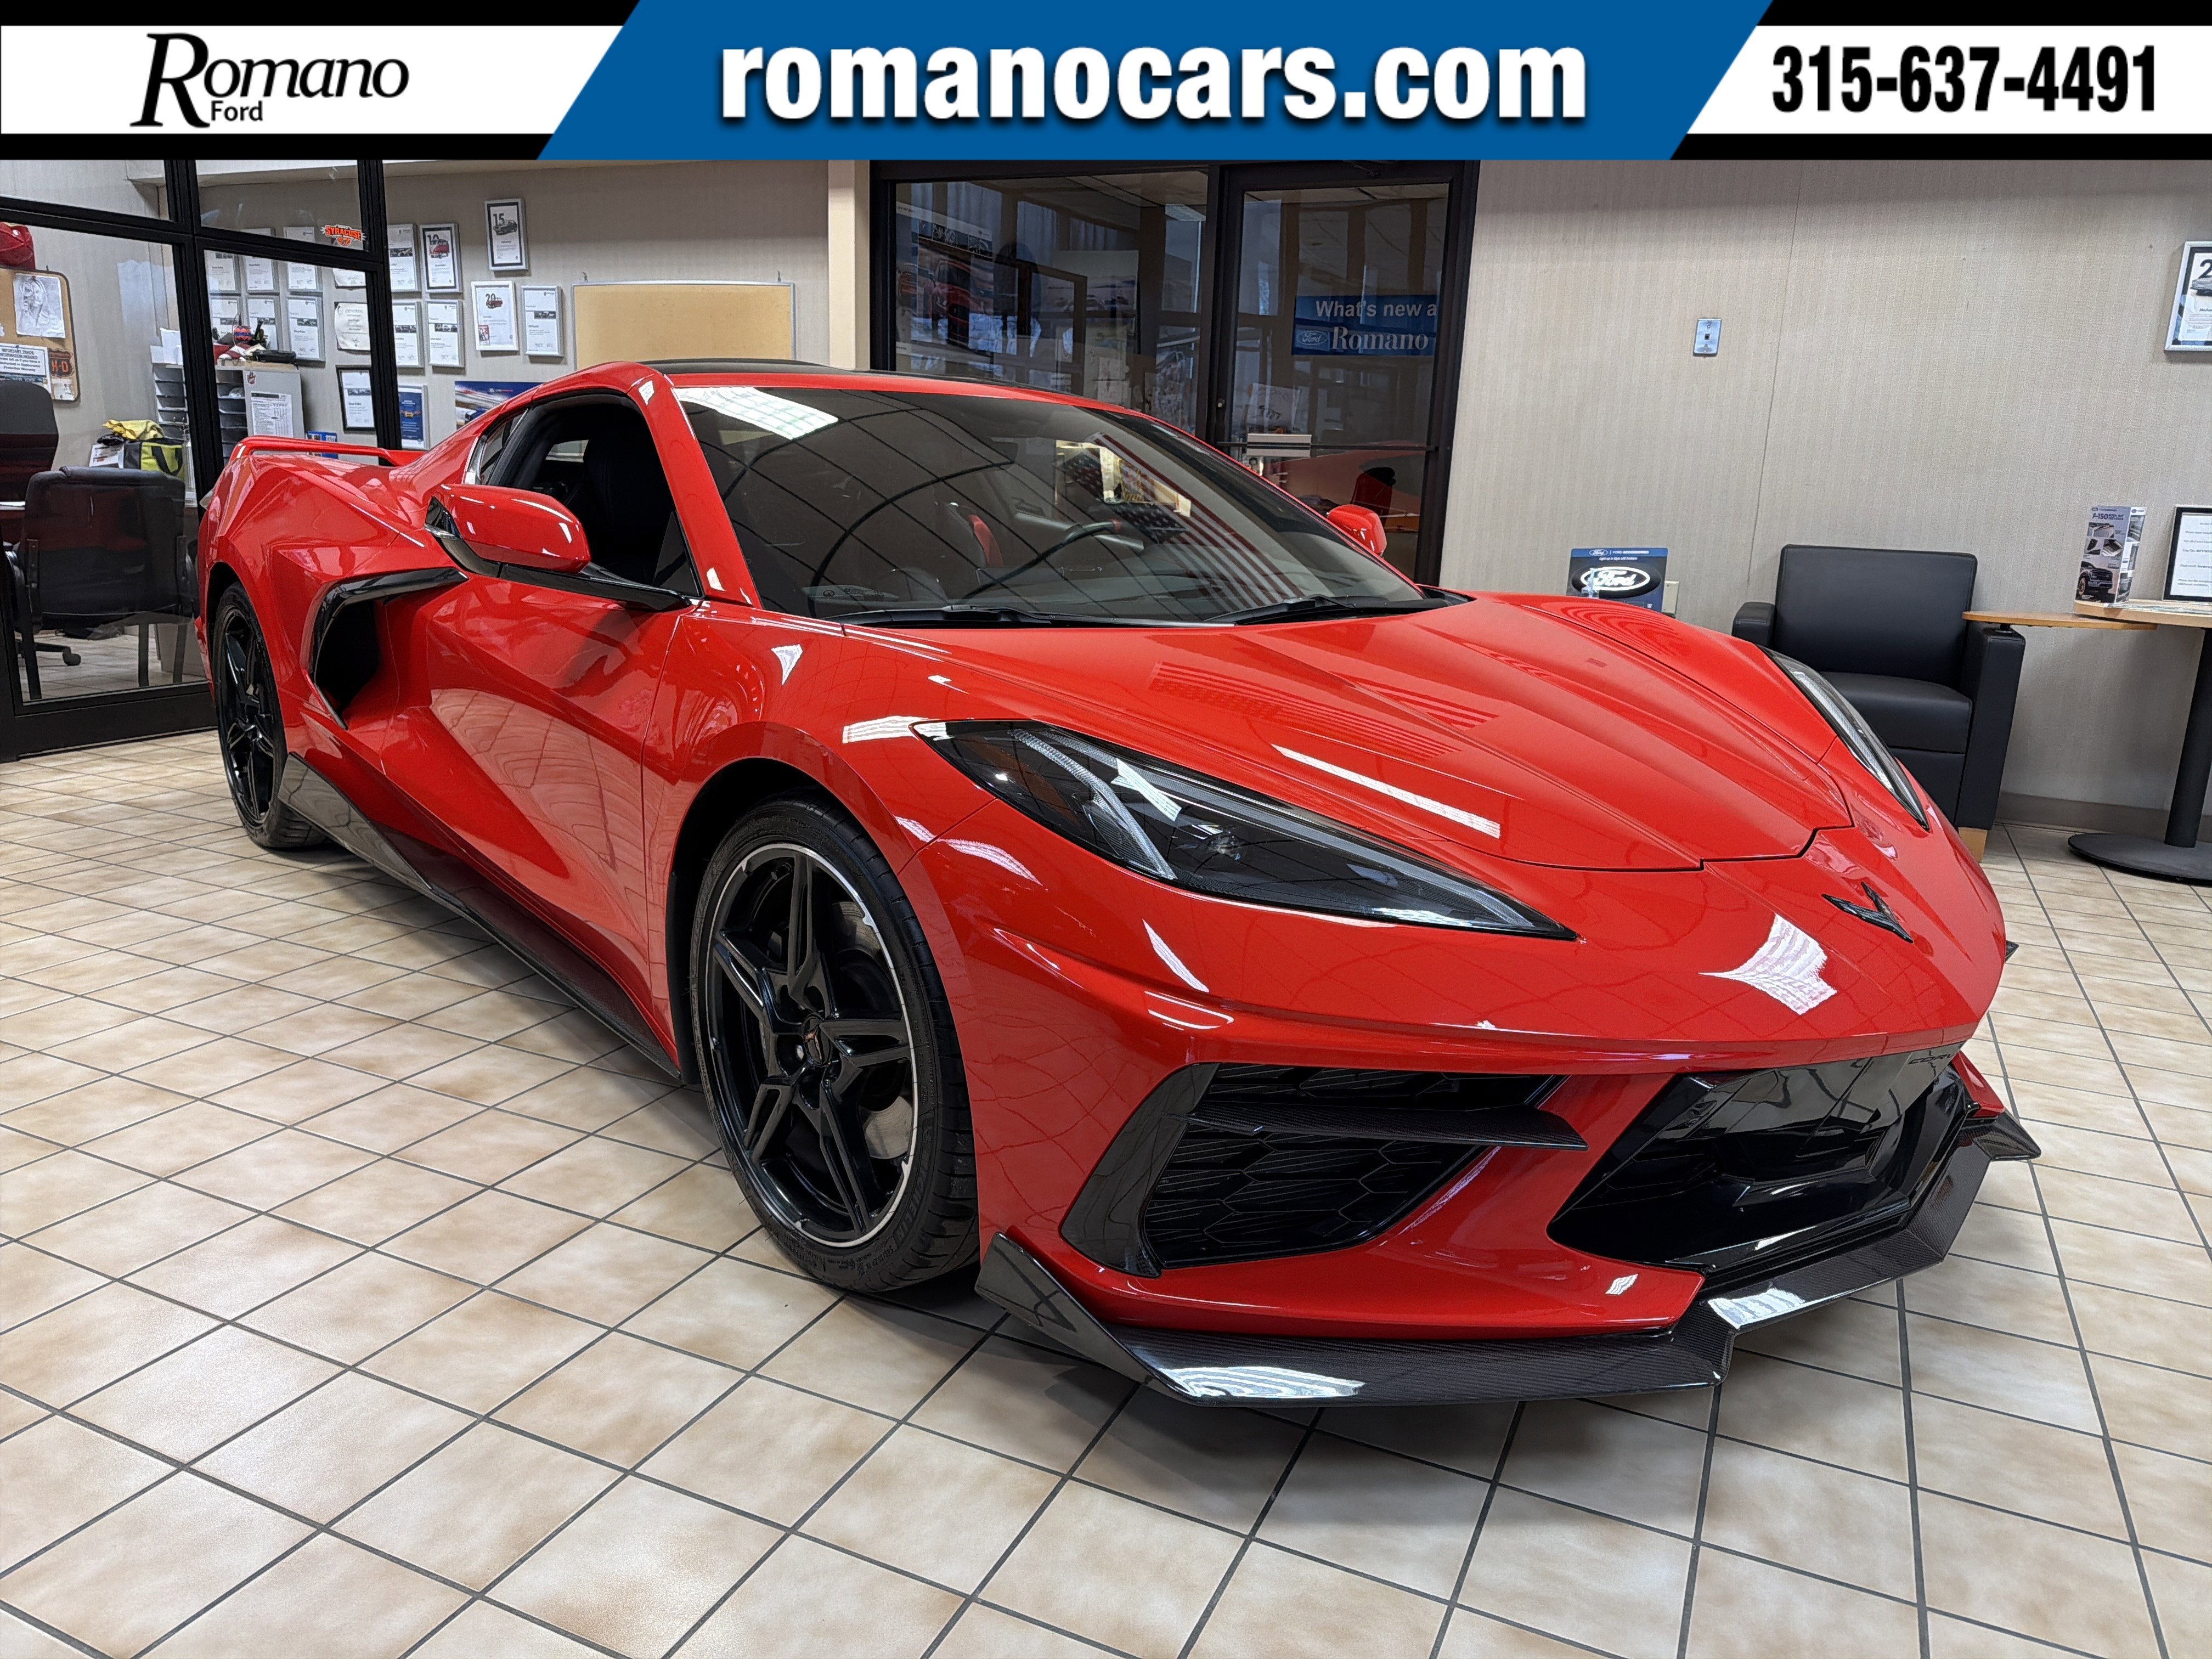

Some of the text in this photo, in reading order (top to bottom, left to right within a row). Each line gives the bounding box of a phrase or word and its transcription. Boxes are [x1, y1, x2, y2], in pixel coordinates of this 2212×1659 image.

[326, 226, 361, 240] SYRACUSE
[1316, 301, 1376, 317] What's
[1383, 303, 1423, 317] new
[1330, 326, 1429, 350] Romano
[1593, 571, 1637, 586] Ford
